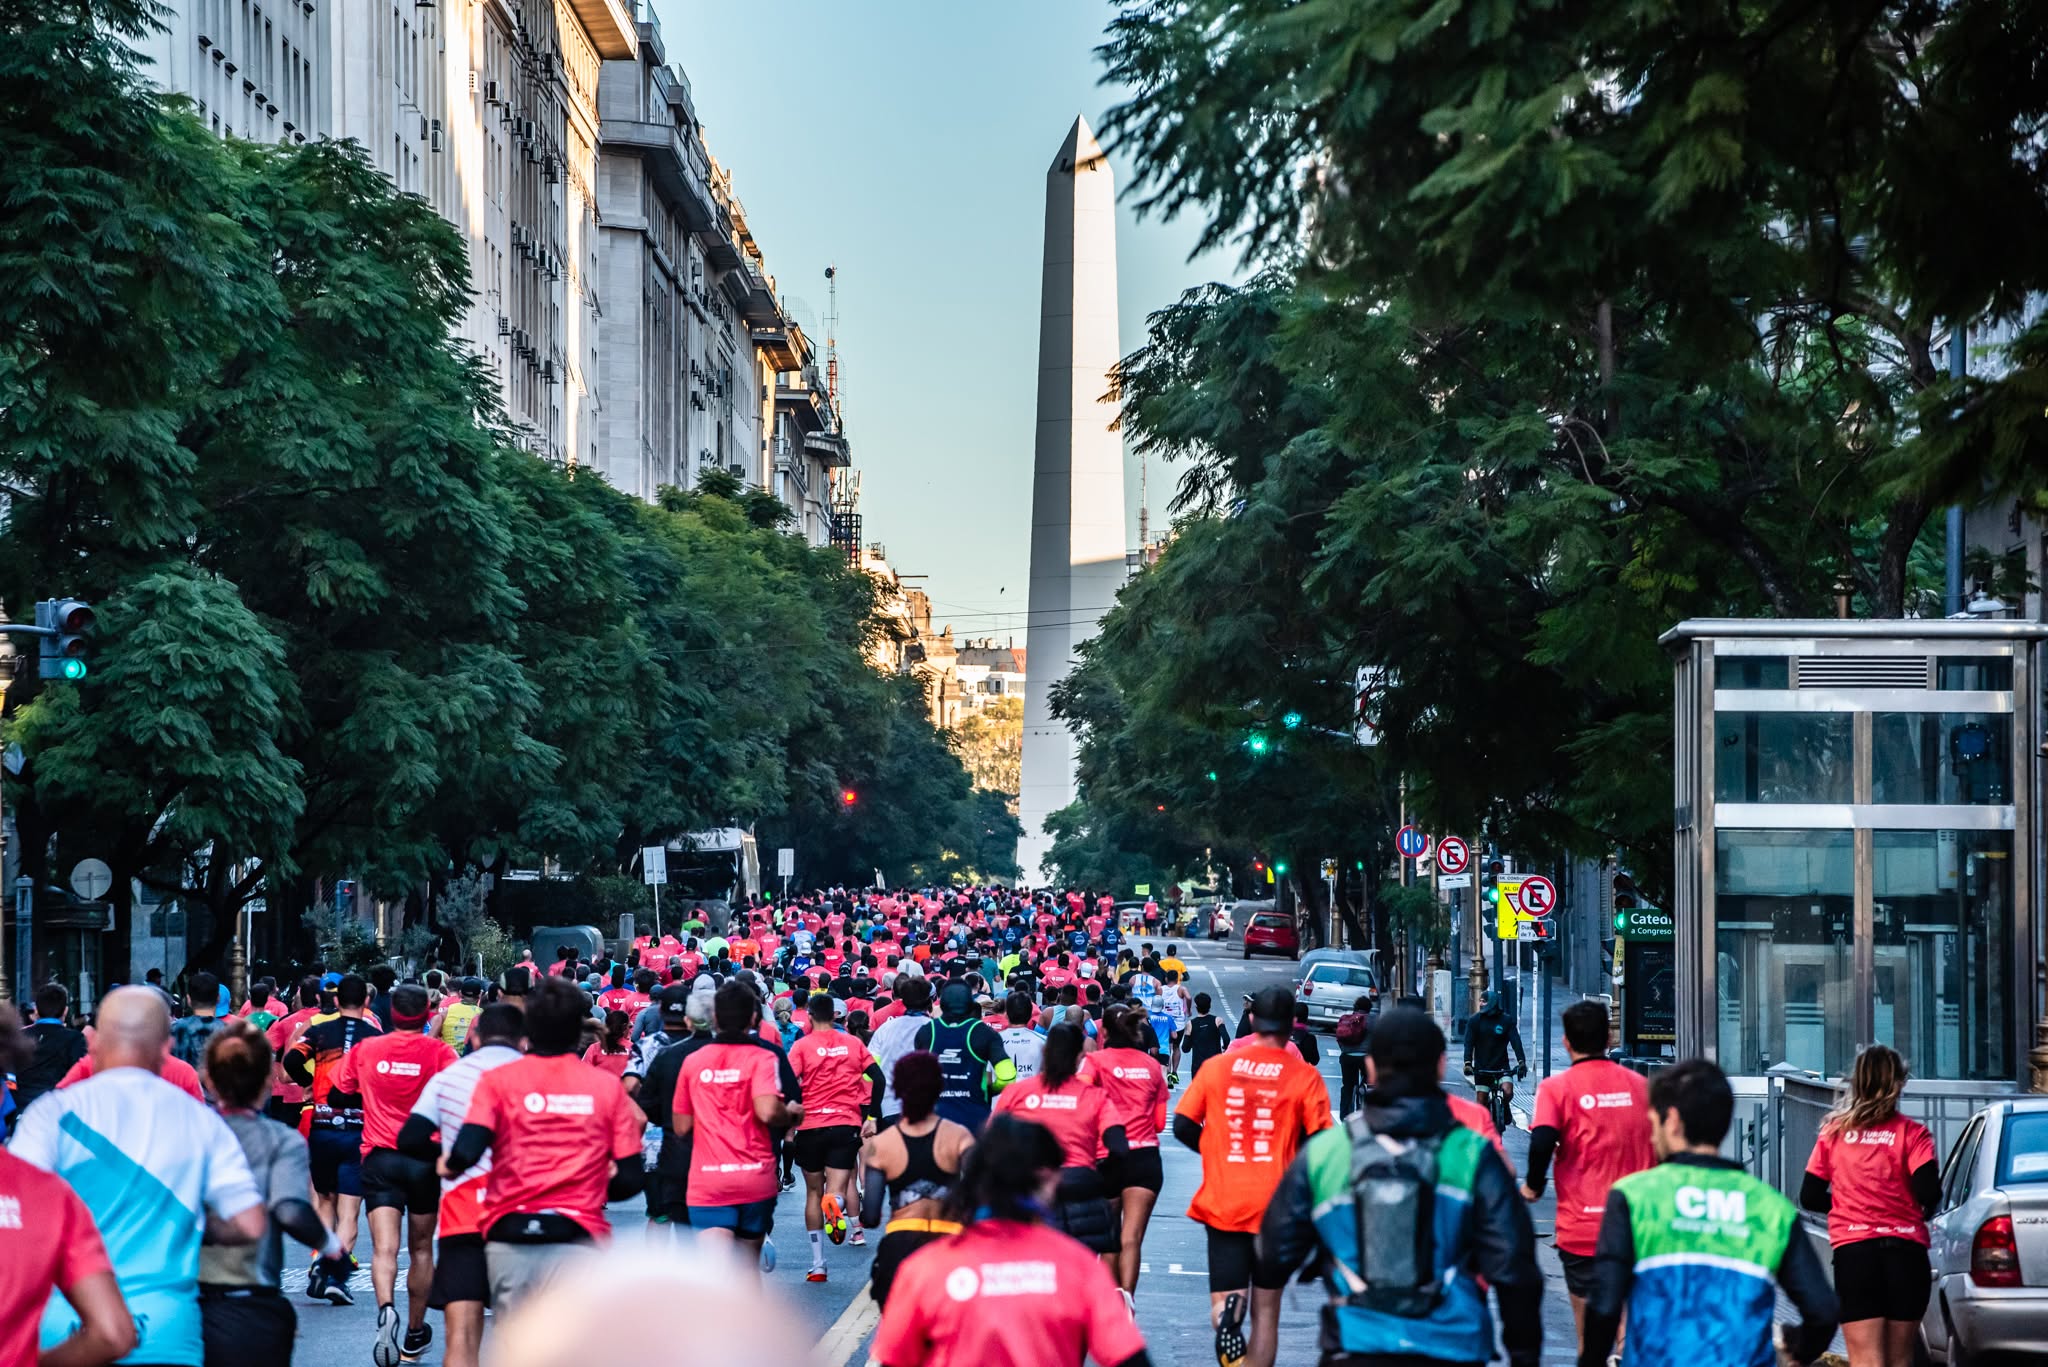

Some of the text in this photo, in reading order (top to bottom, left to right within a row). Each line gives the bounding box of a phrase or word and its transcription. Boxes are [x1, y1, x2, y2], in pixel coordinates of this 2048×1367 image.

[1637, 927, 1672, 936] Congreso
[1018, 1063, 1033, 1073] 21K
[1231, 1058, 1284, 1077] GALGOS
[1675, 1185, 1746, 1224] CM
